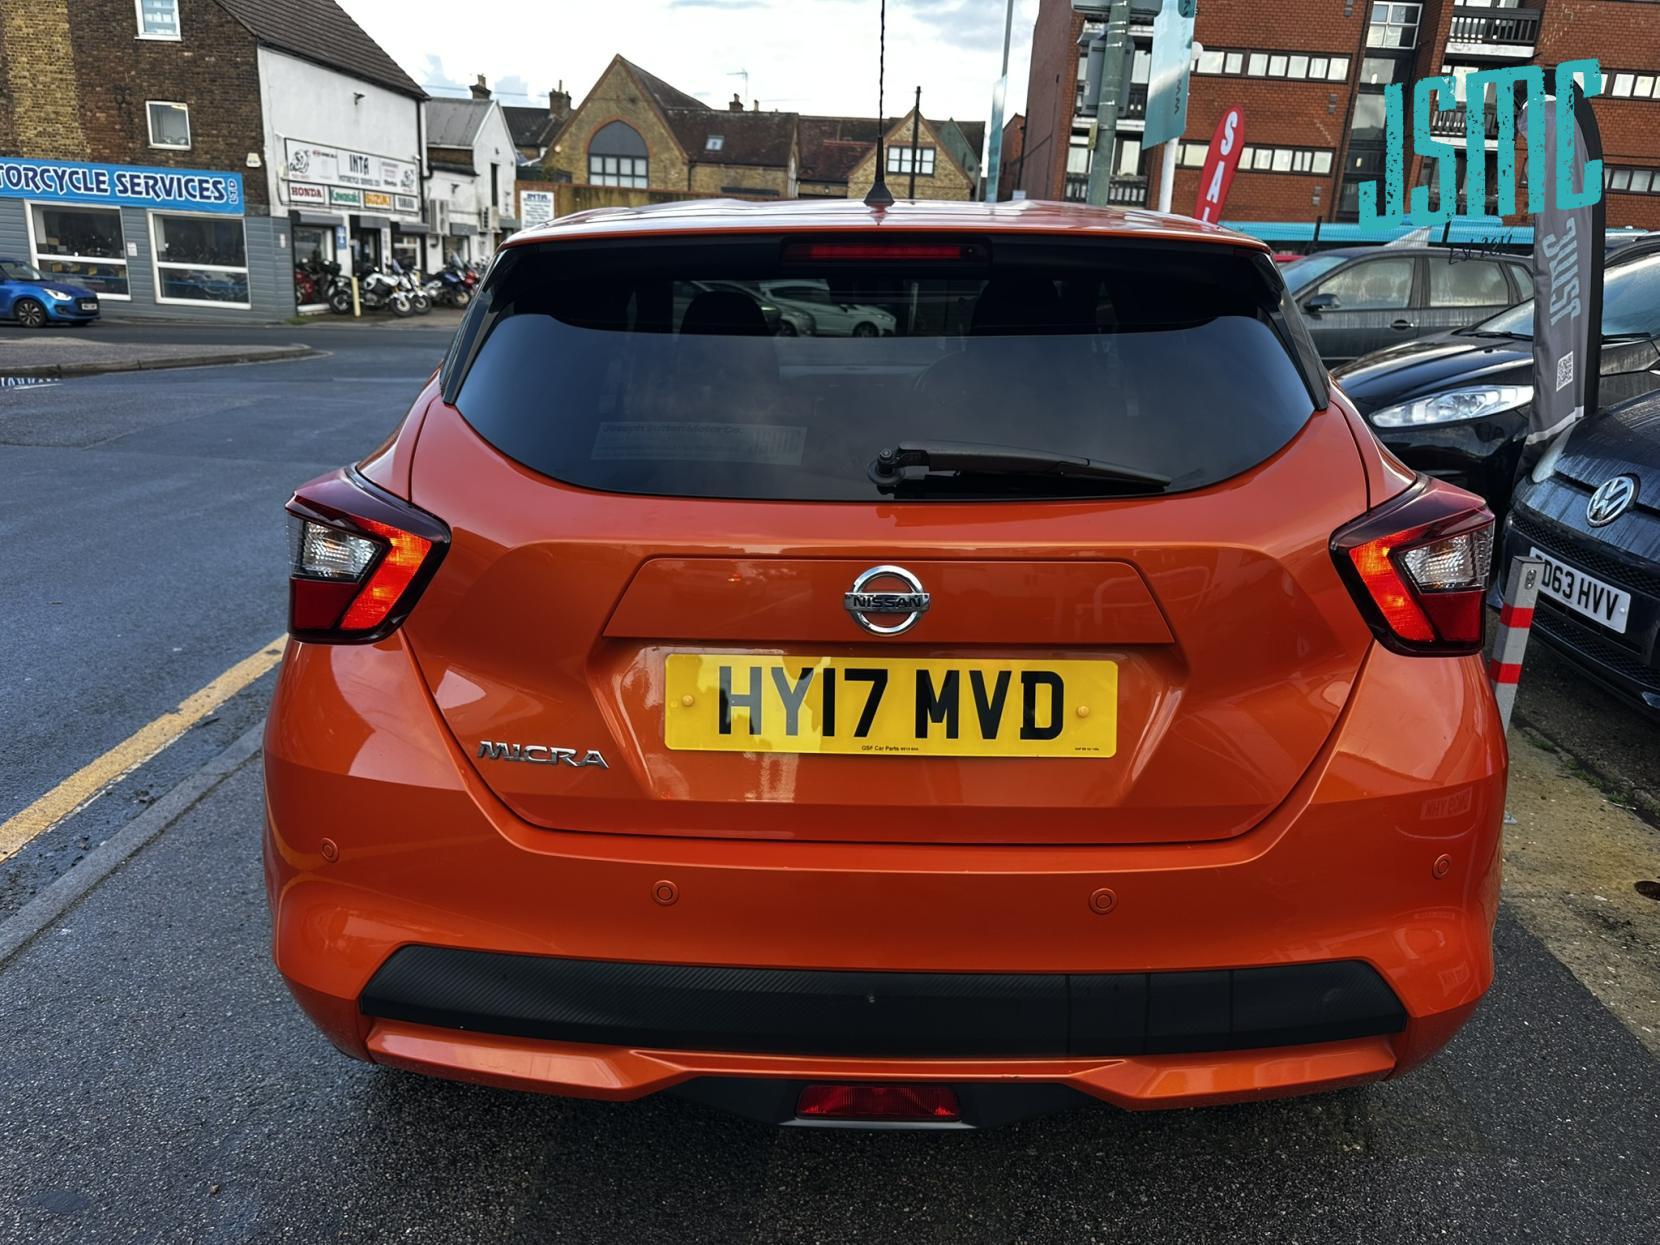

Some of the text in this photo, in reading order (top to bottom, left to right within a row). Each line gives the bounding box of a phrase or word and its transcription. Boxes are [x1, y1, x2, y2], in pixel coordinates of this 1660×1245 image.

[114, 171, 227, 204] SERVICES
[290, 187, 322, 198] HONDA
[853, 596, 921, 608] NISSAN
[1577, 577, 1620, 621] HVV
[718, 666, 1065, 740] HY17 MVD
[478, 740, 608, 769] MICRA
